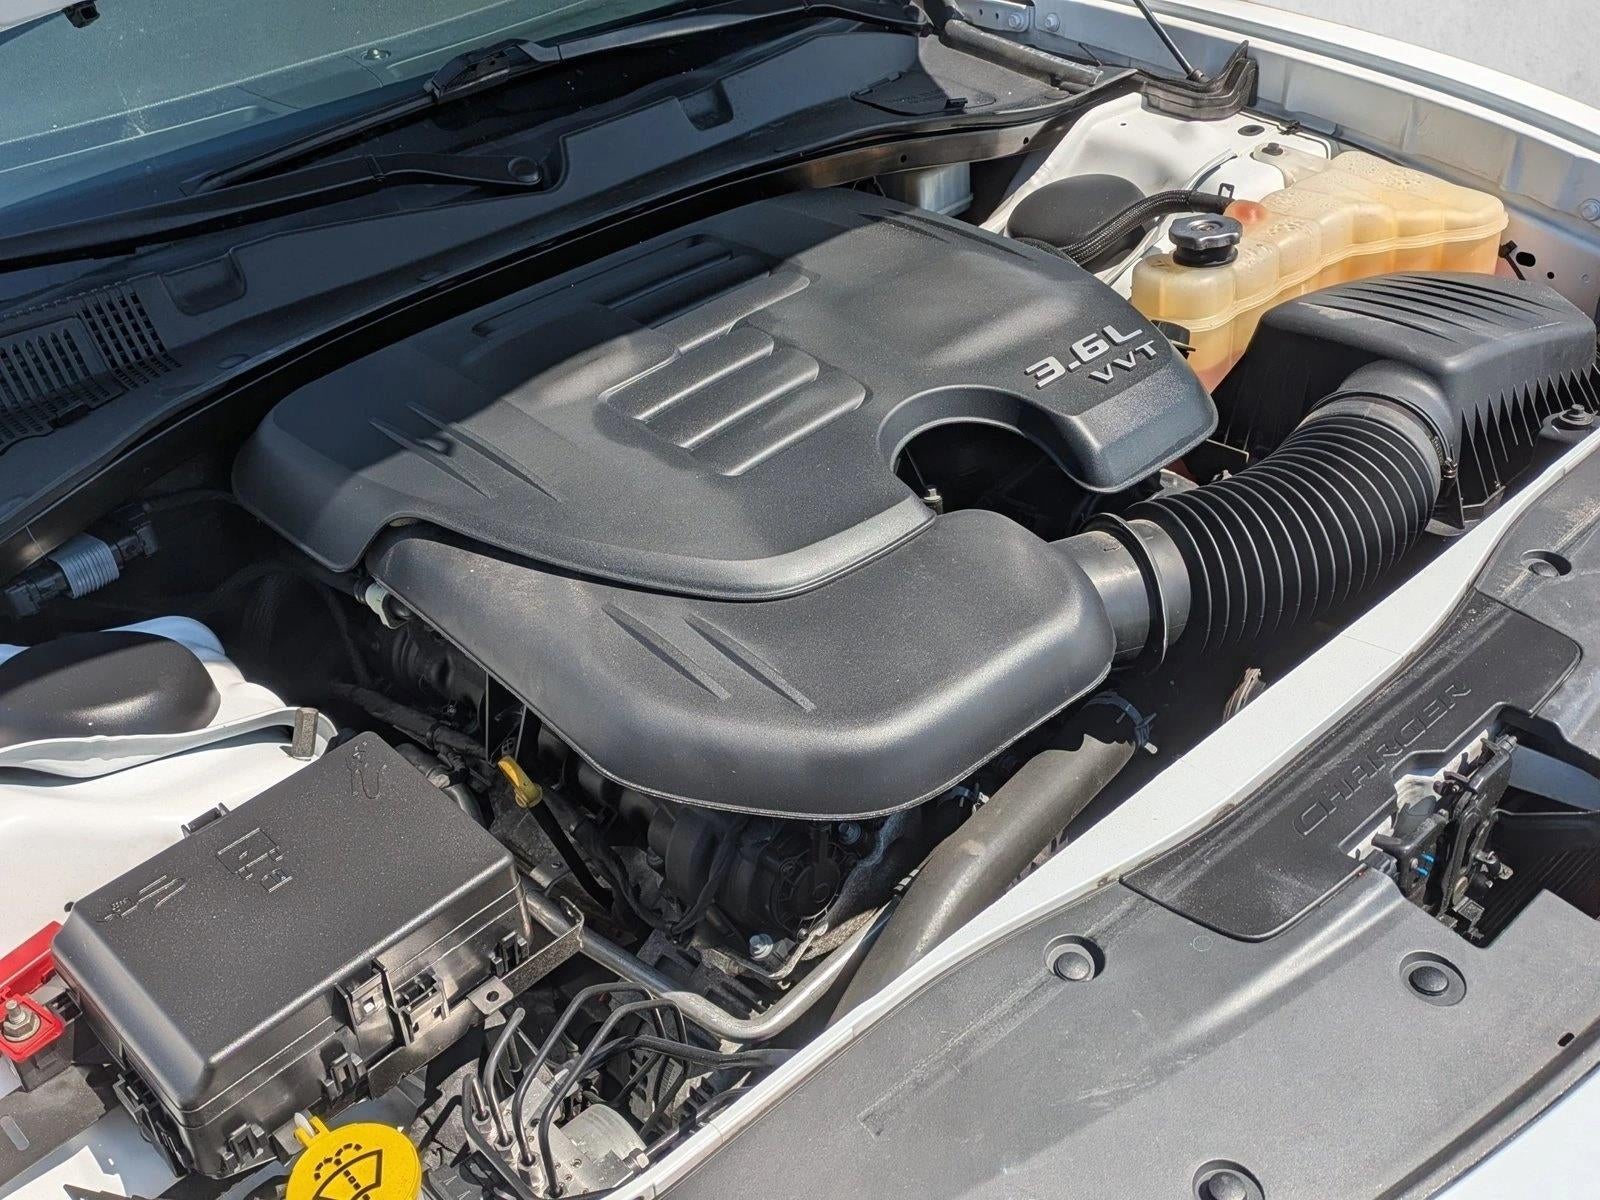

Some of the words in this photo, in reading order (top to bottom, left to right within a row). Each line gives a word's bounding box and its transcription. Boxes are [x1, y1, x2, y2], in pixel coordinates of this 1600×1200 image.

[1024, 325, 1143, 390] 3.6L
[1088, 340, 1157, 384] VVT
[1293, 683, 1472, 836] CHARGER
